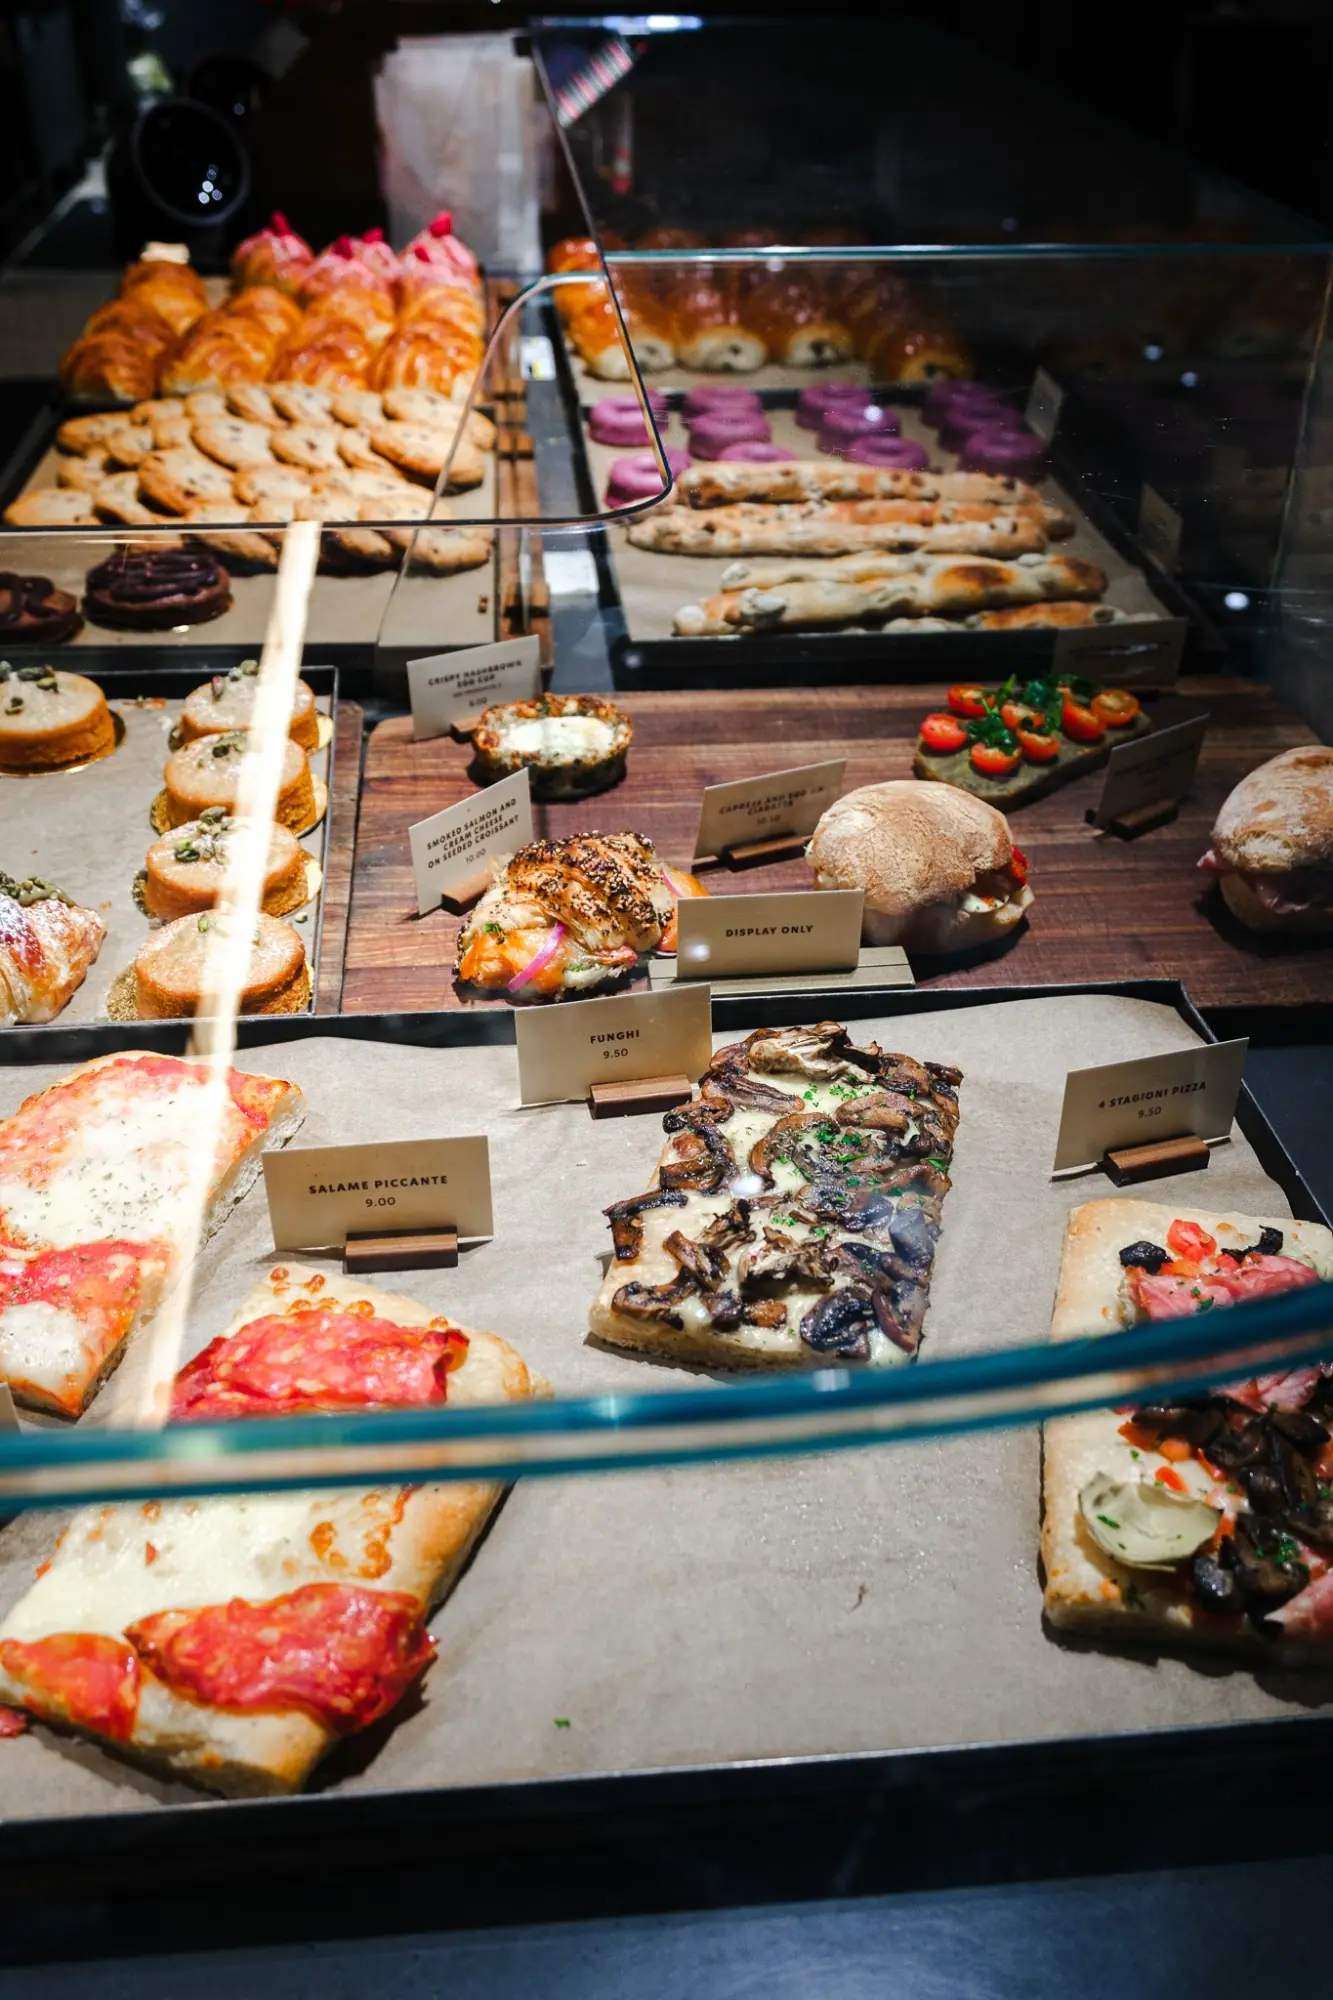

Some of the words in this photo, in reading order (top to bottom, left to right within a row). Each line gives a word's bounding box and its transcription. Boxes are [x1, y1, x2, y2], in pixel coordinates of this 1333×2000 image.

[428, 672, 460, 687] CRISPY
[427, 826, 462, 851] SMOKED
[464, 808, 498, 830] SALMON
[500, 798, 517, 812] AND
[443, 831, 472, 852] CREAM
[474, 814, 504, 835] CHEESE
[427, 858, 441, 870] ON
[443, 840, 473, 862] SEEDED
[475, 814, 520, 844] CROISSANT
[725, 926, 778, 938] DISPLAY
[781, 924, 815, 934] ONLY
[590, 1029, 640, 1044] FUNGHI
[603, 1047, 629, 1060] 9.50
[1098, 1100, 1106, 1109] 4
[1109, 1087, 1169, 1108] STAGIONI
[1171, 1080, 1207, 1096] PIZZA
[1137, 1105, 1162, 1119] 9.50
[308, 1180, 370, 1195] SALAME
[374, 1174, 448, 1190] PICCANTE
[365, 1196, 396, 1208] 9.00
